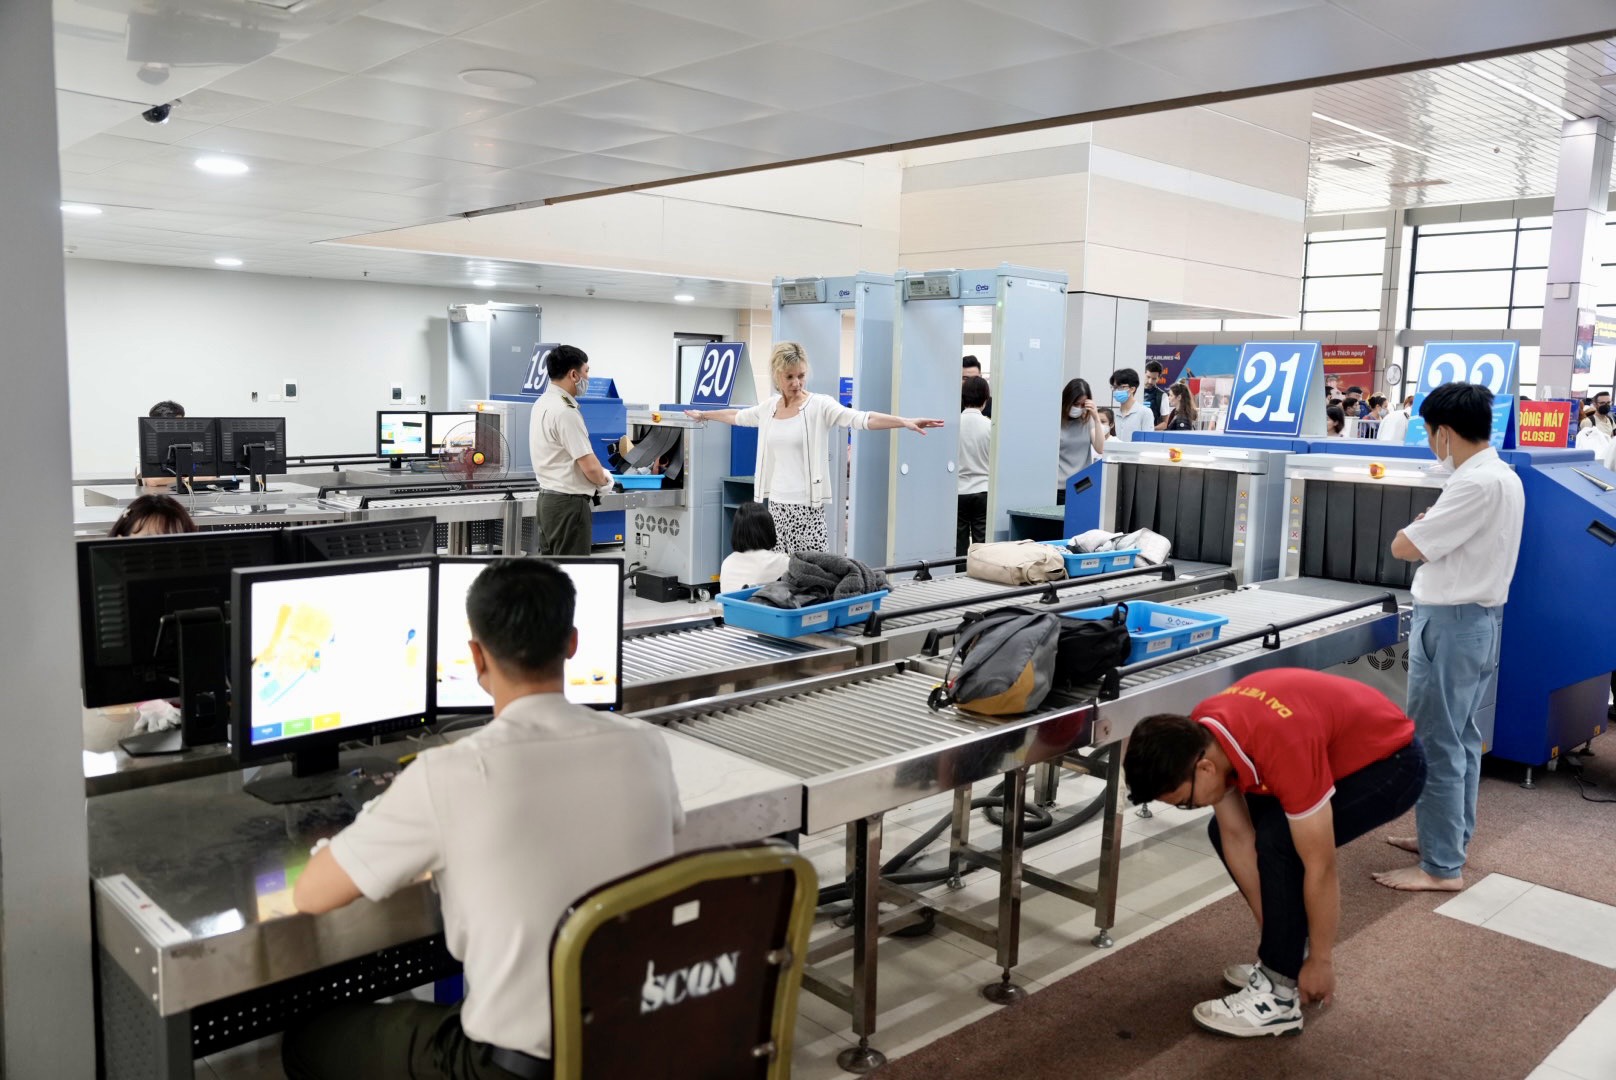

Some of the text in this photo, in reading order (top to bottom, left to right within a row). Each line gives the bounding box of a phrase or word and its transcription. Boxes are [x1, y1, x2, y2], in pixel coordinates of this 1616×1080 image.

[523, 350, 551, 390] 19
[696, 348, 735, 397] 20
[1233, 351, 1301, 423] 21
[1521, 430, 1556, 442] CLOSED
[1543, 409, 1565, 428] MÁY
